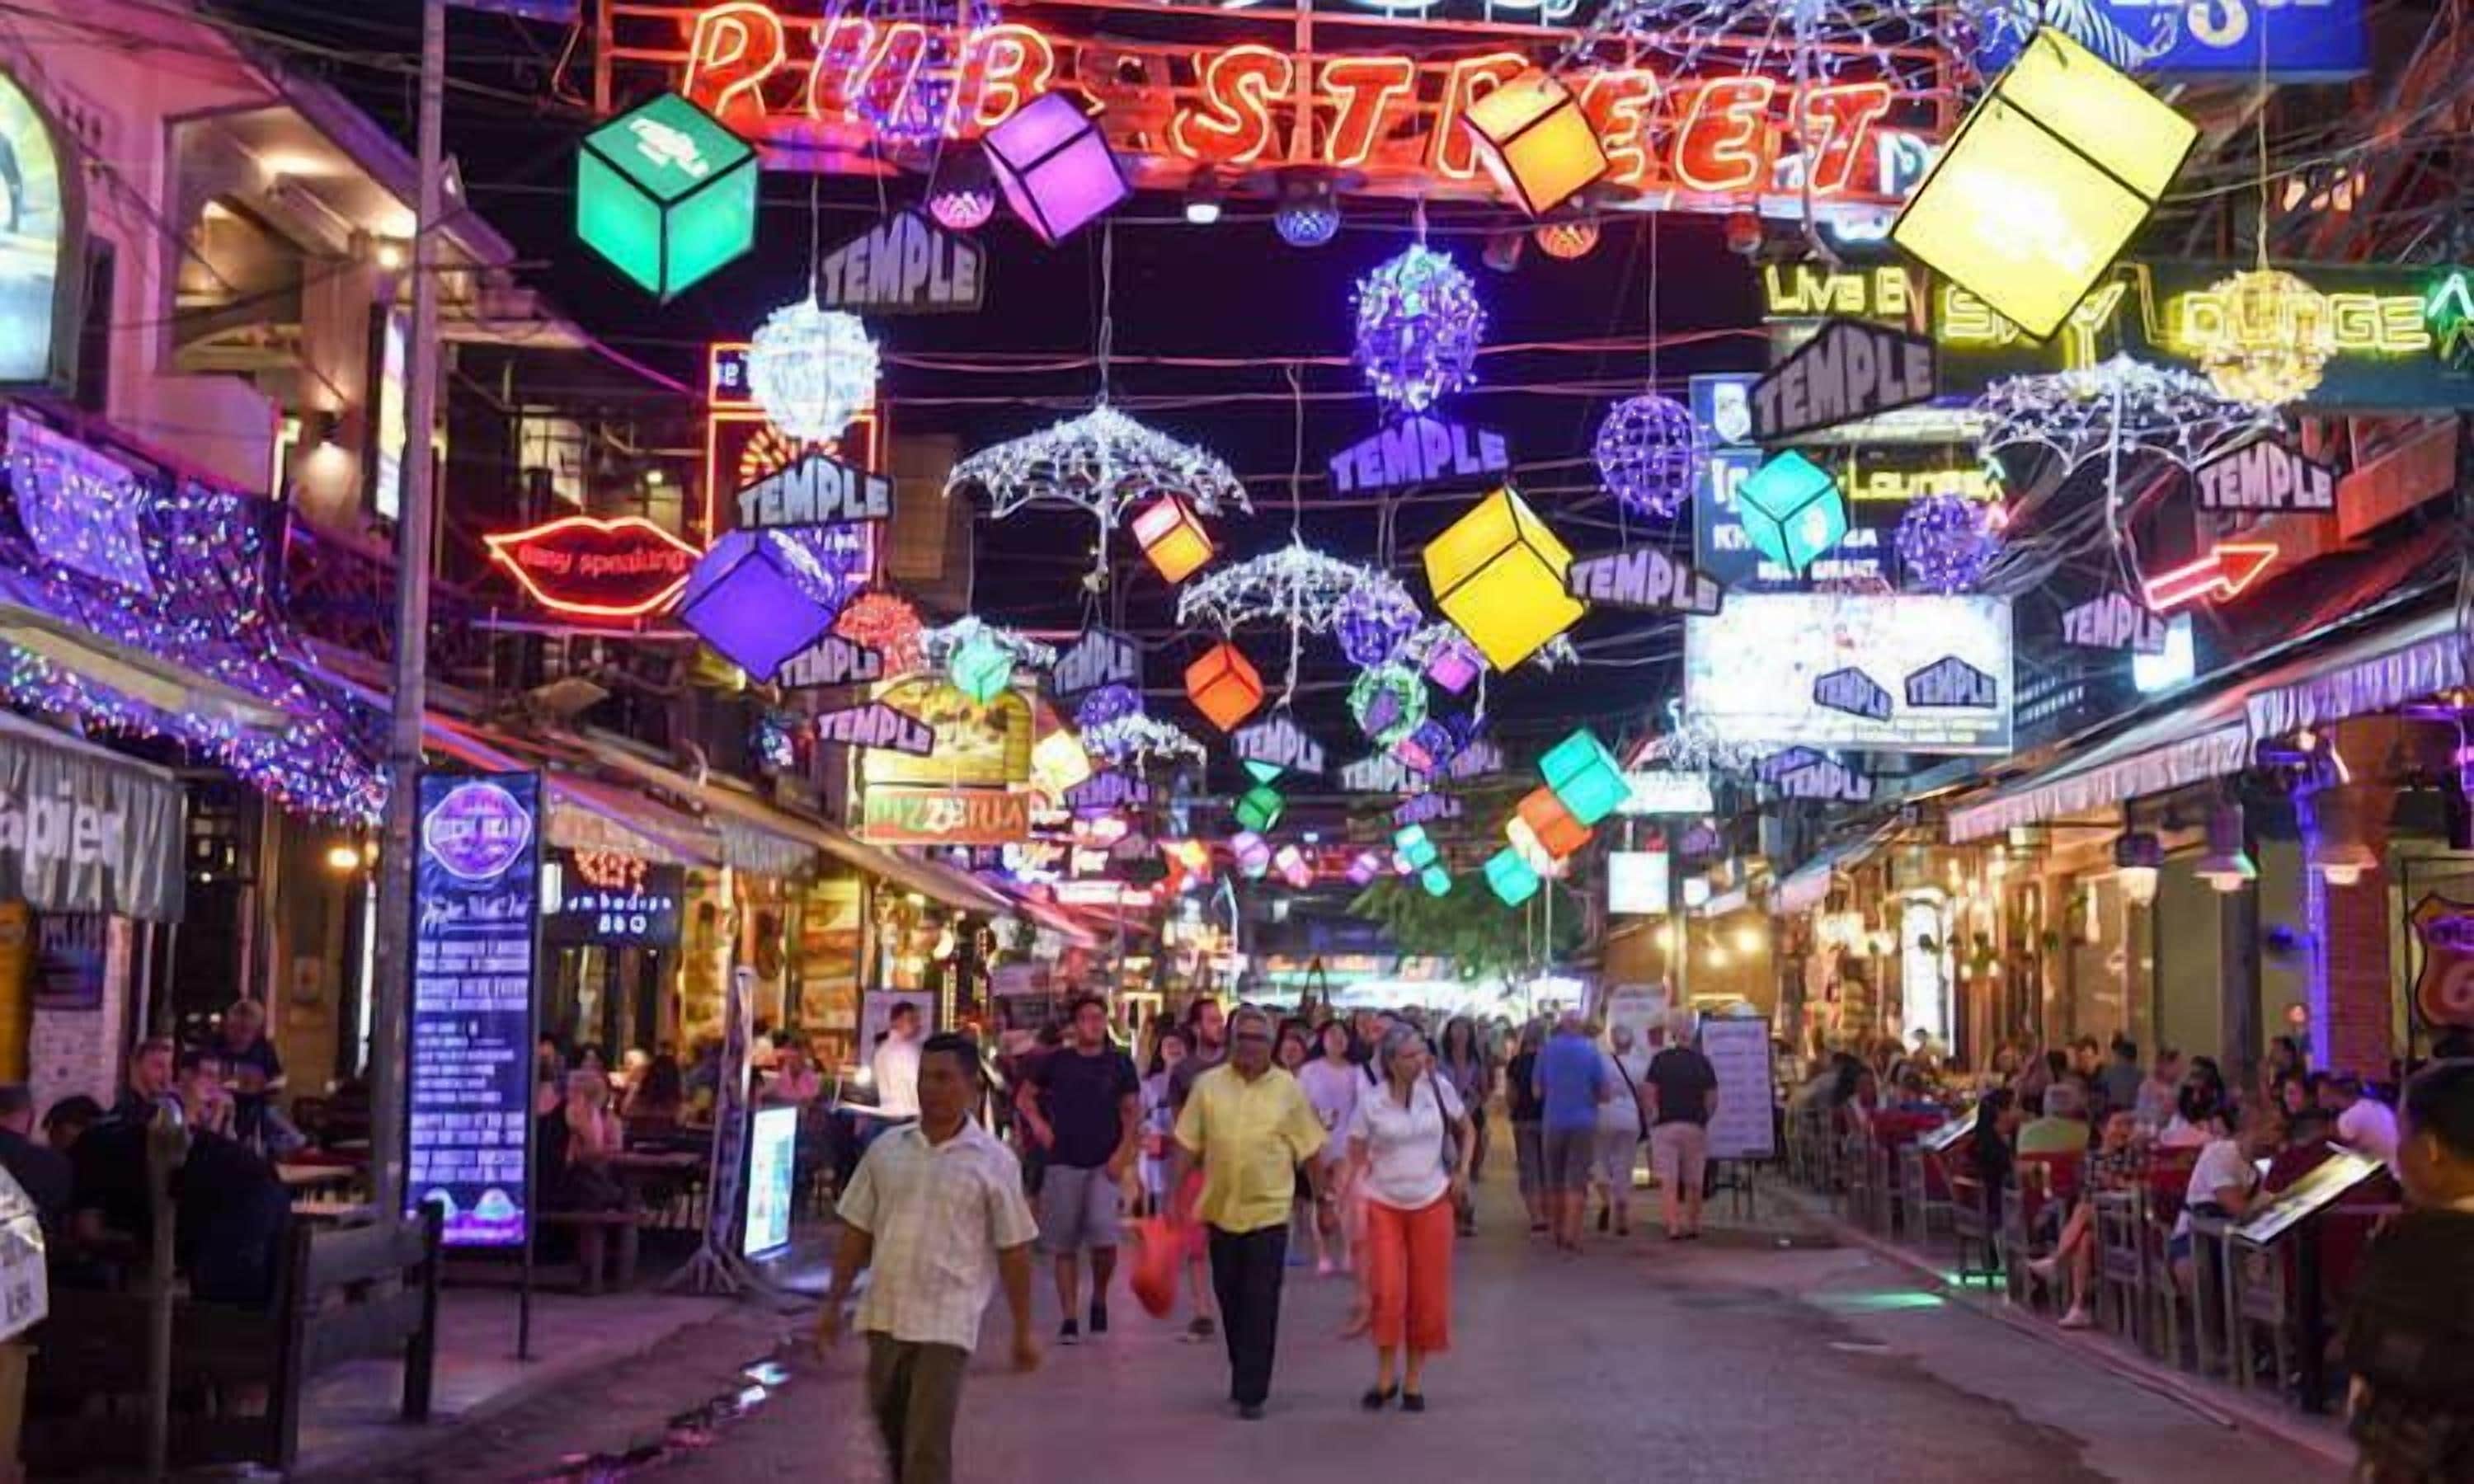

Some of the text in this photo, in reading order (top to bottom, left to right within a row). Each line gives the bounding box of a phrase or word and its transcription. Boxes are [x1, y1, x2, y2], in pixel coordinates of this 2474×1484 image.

[681, 2, 1056, 139] PUB
[821, 211, 976, 304] TEMPLE
[1754, 324, 1933, 435] TEMPLE
[1329, 416, 1508, 491] TEMPLE
[2199, 440, 2333, 508] TEMPLE
[737, 456, 889, 528] TEMPLE
[1569, 548, 1718, 613] TEMPLE
[2062, 591, 2166, 654] TEMPLE
